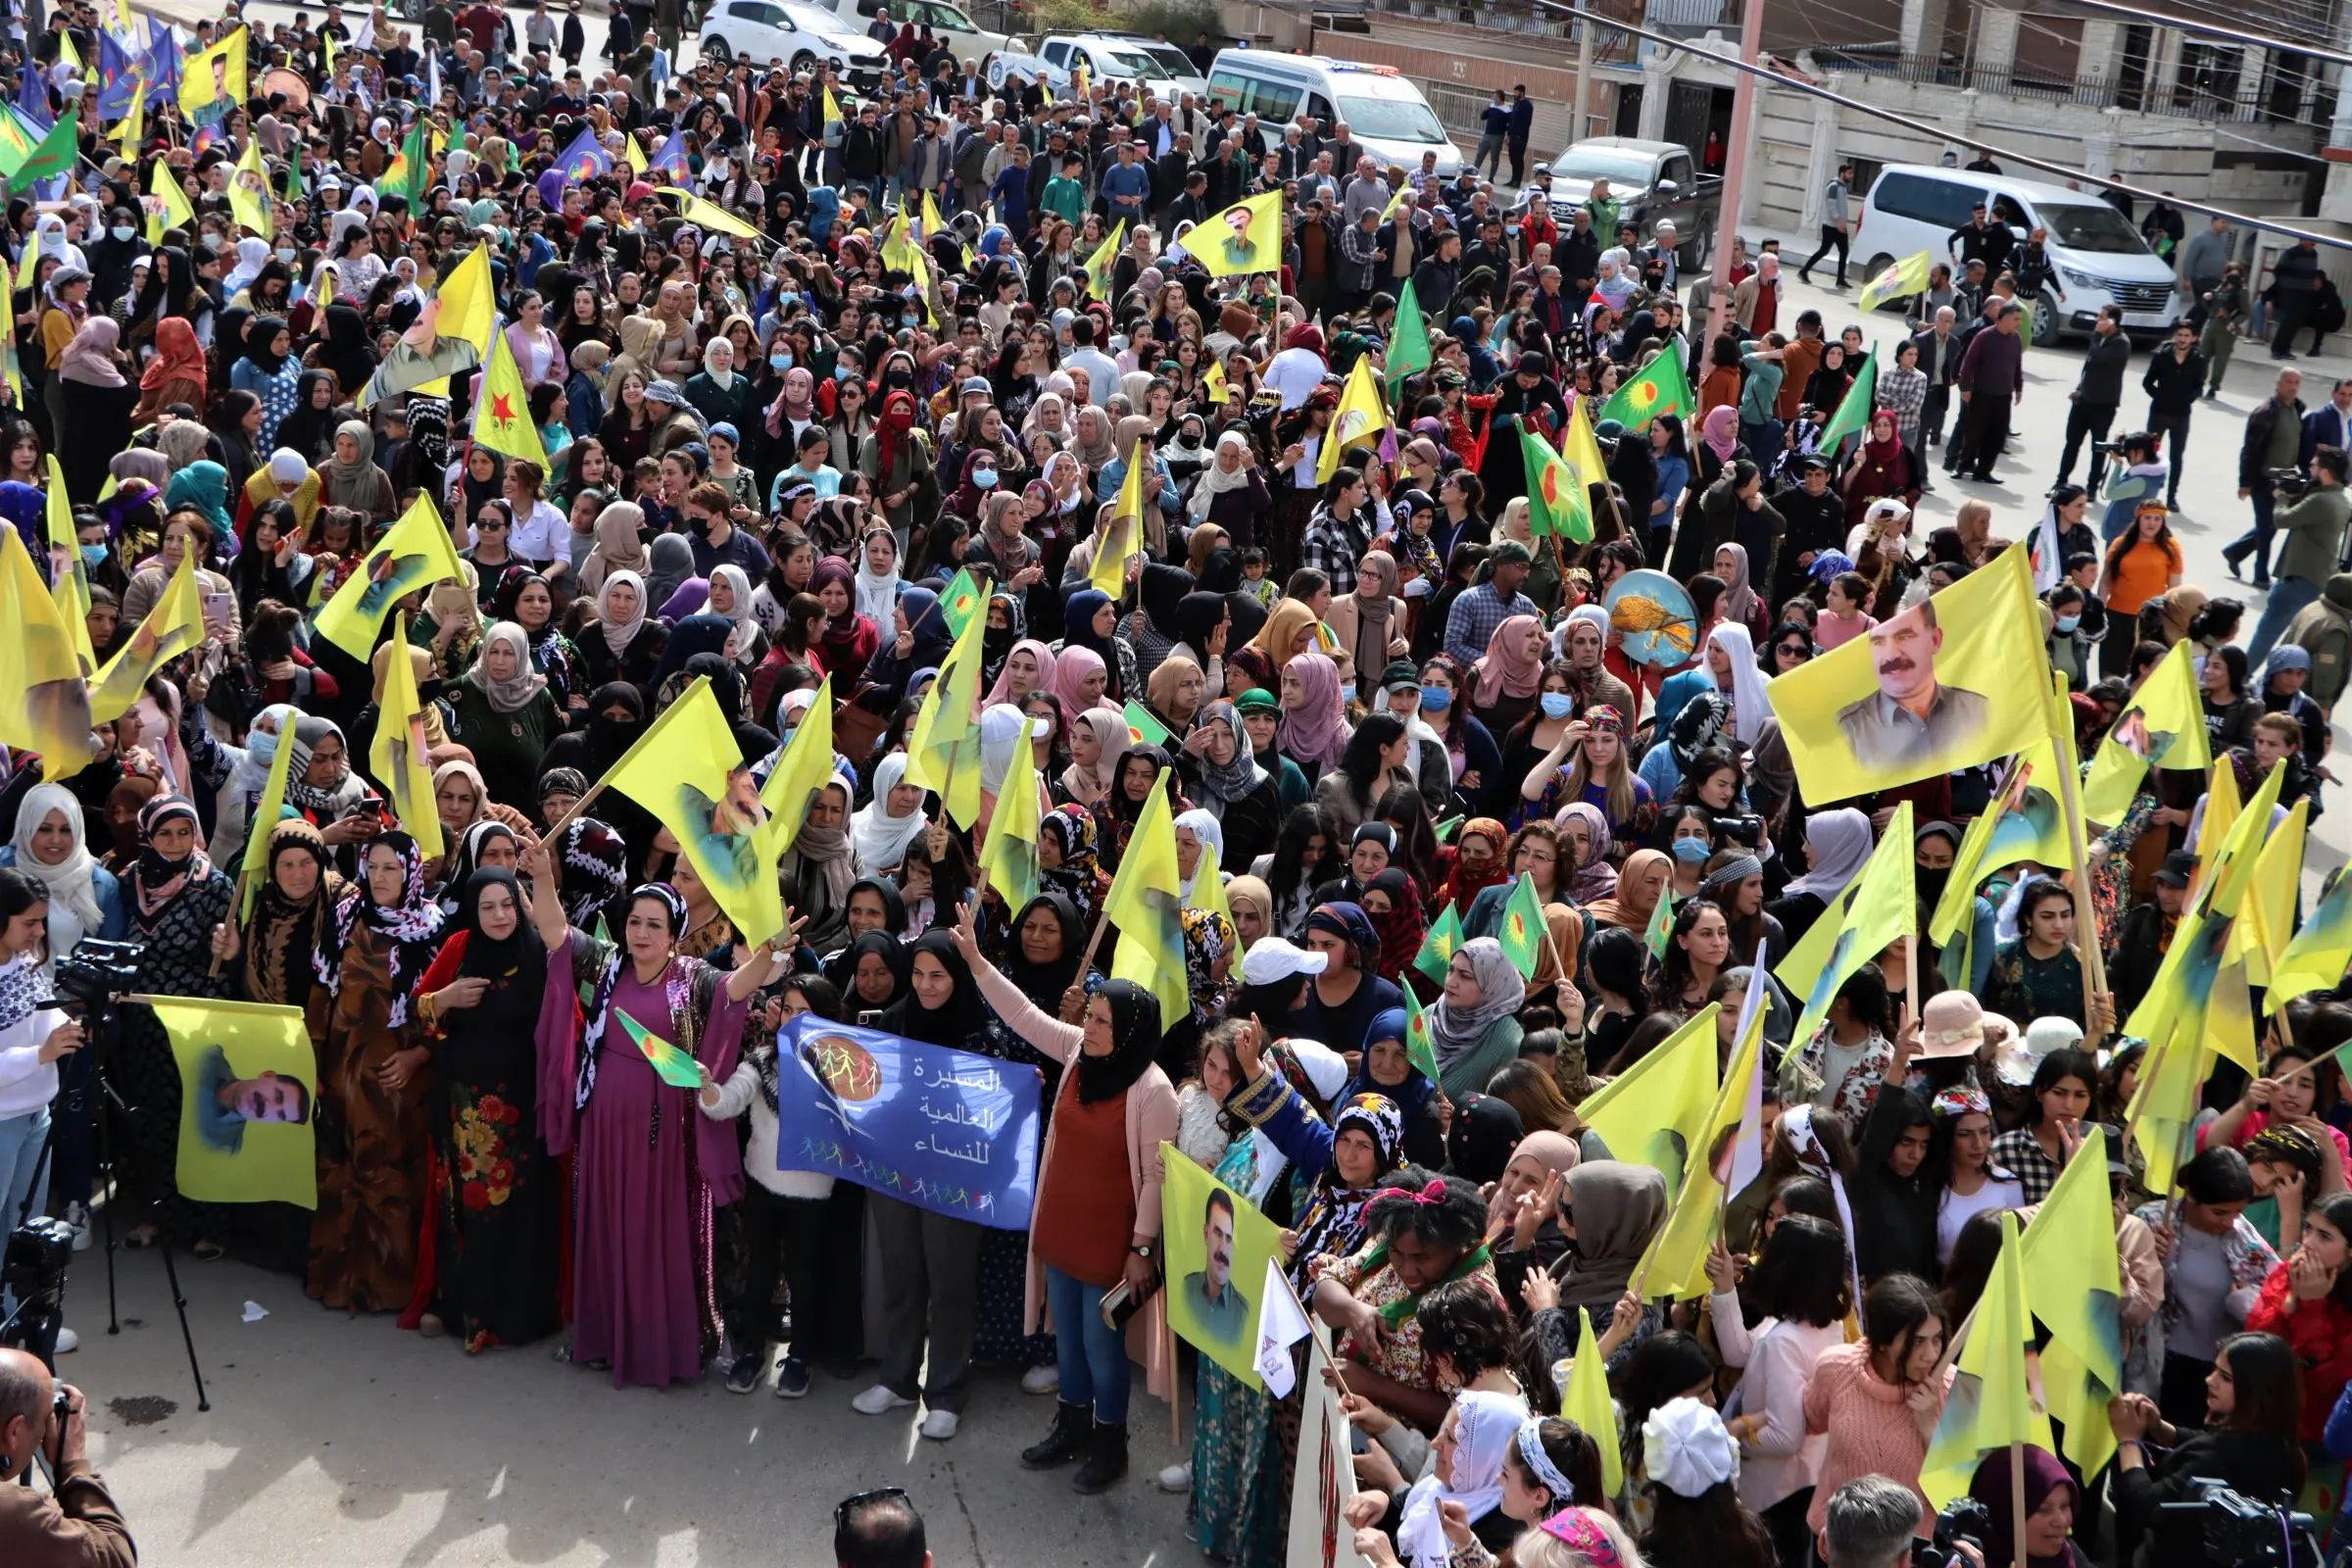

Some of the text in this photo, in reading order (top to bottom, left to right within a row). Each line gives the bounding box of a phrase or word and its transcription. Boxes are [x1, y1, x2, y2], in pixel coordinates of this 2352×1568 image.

[913, 1057, 1001, 1093] المسيرة
[919, 1095, 994, 1129] العالمية
[914, 1133, 990, 1164] للنساء
